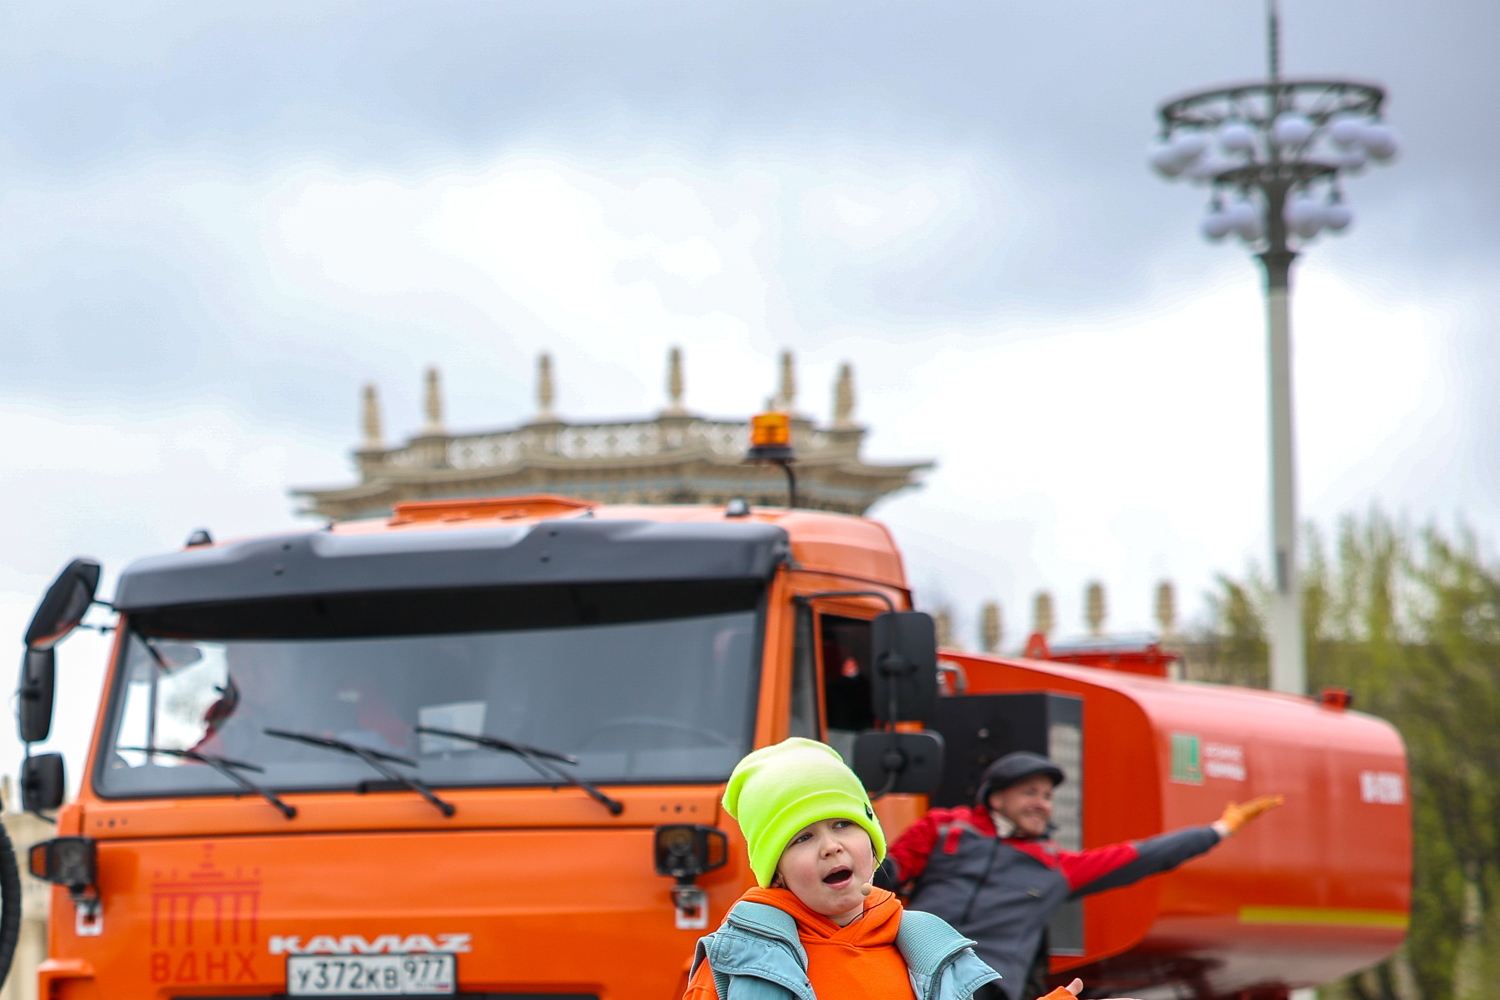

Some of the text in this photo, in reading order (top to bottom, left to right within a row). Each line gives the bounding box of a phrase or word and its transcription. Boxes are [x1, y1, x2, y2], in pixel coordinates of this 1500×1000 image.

[269, 935, 472, 955] KAMAZ
[151, 952, 258, 982] ВДНХ
[404, 958, 444, 981] 977
